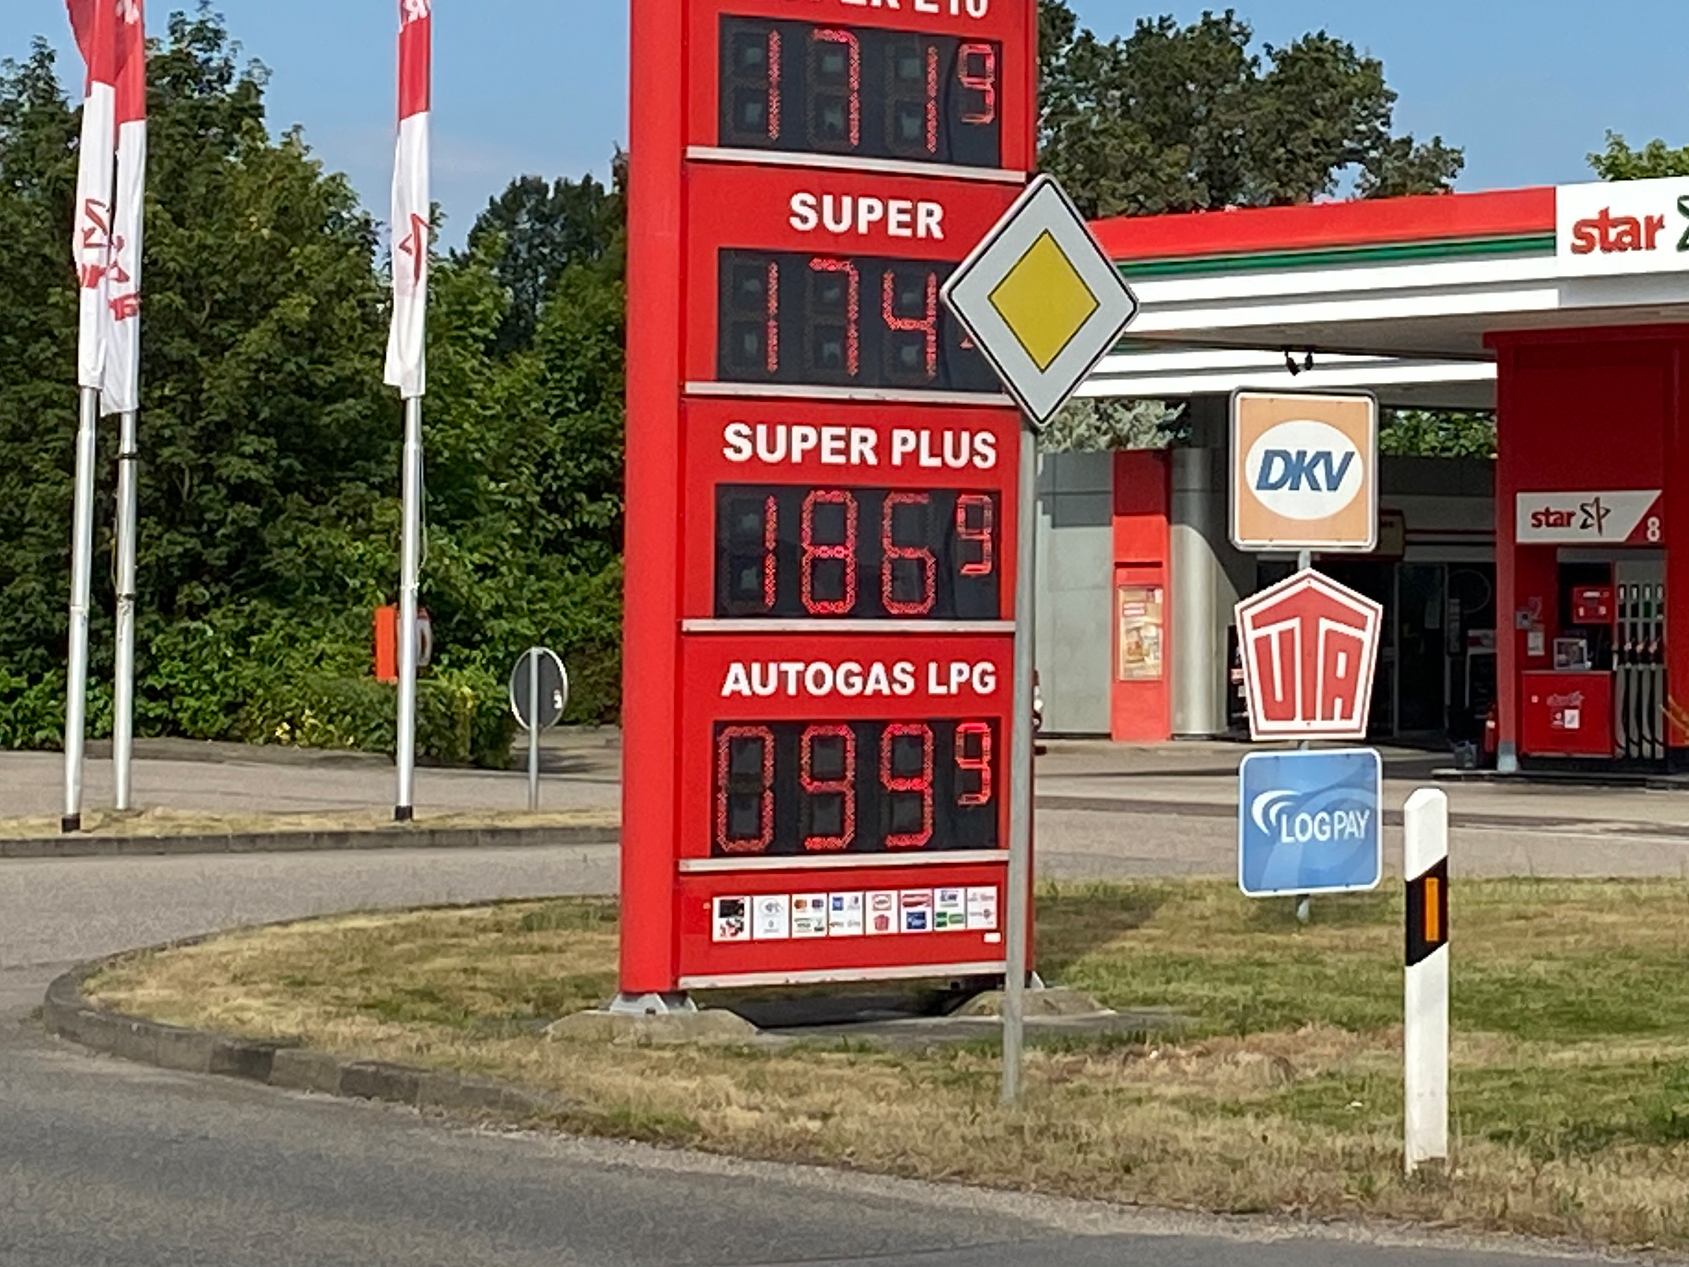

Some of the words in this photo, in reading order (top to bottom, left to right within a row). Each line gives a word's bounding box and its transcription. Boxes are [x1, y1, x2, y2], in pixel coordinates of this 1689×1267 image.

[790, 192, 944, 239] SUPER
[1570, 206, 1665, 255] star
[766, 257, 975, 379] 174
[723, 423, 877, 465] SUPER
[891, 429, 996, 469] PLUS
[1256, 449, 1355, 492] DKV
[1531, 506, 1576, 528] star
[1646, 516, 1661, 542] 8
[1251, 586, 1369, 722] UTA
[721, 661, 916, 696] AUTOGAS
[928, 662, 997, 695] LPG
[1281, 809, 1371, 843] LOGPAY
